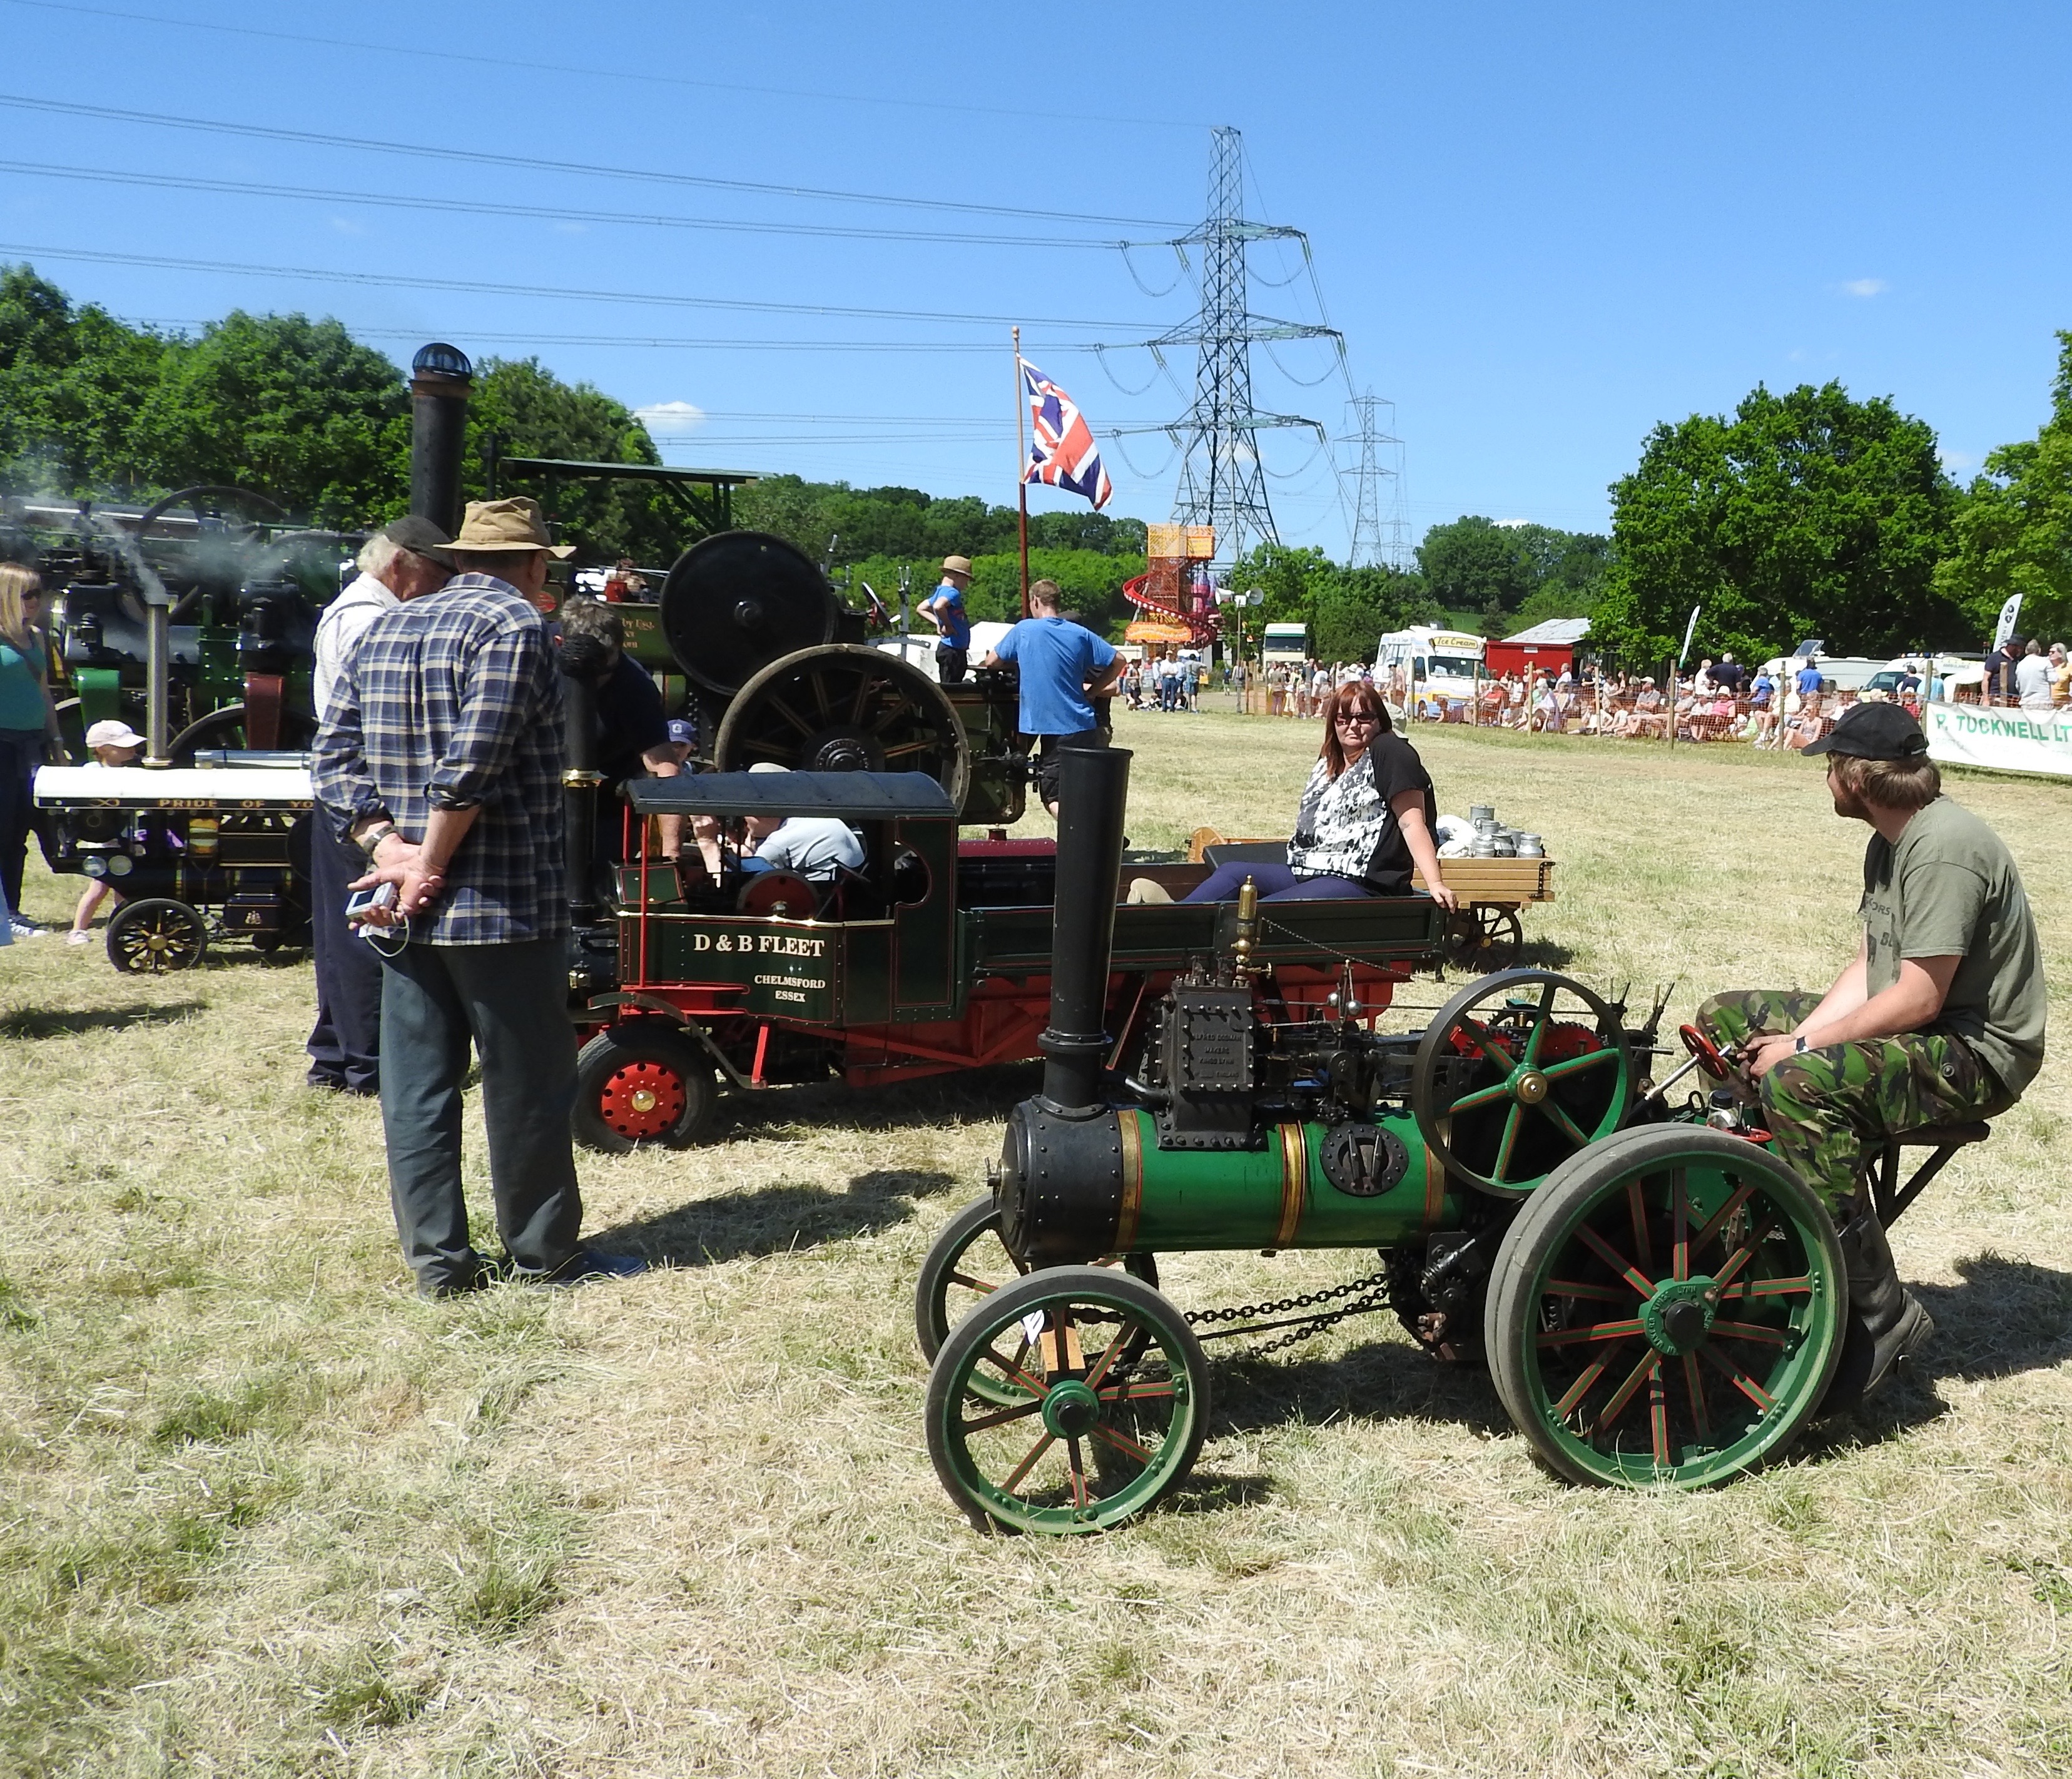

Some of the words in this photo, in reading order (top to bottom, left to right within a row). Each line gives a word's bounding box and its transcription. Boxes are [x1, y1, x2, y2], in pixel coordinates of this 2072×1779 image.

[1450, 638, 1476, 647] Cream
[1956, 715, 2049, 741] TUCKWELL
[158, 799, 218, 808] PRIDE
[241, 799, 266, 808] OF
[693, 933, 711, 951] D
[716, 934, 733, 952] &
[738, 935, 753, 952] B
[758, 935, 825, 957] FLEET
[754, 975, 826, 990] CHELMSFORD
[774, 990, 806, 1003] ESSEX
[1677, 1285, 1697, 1294] LYNN
